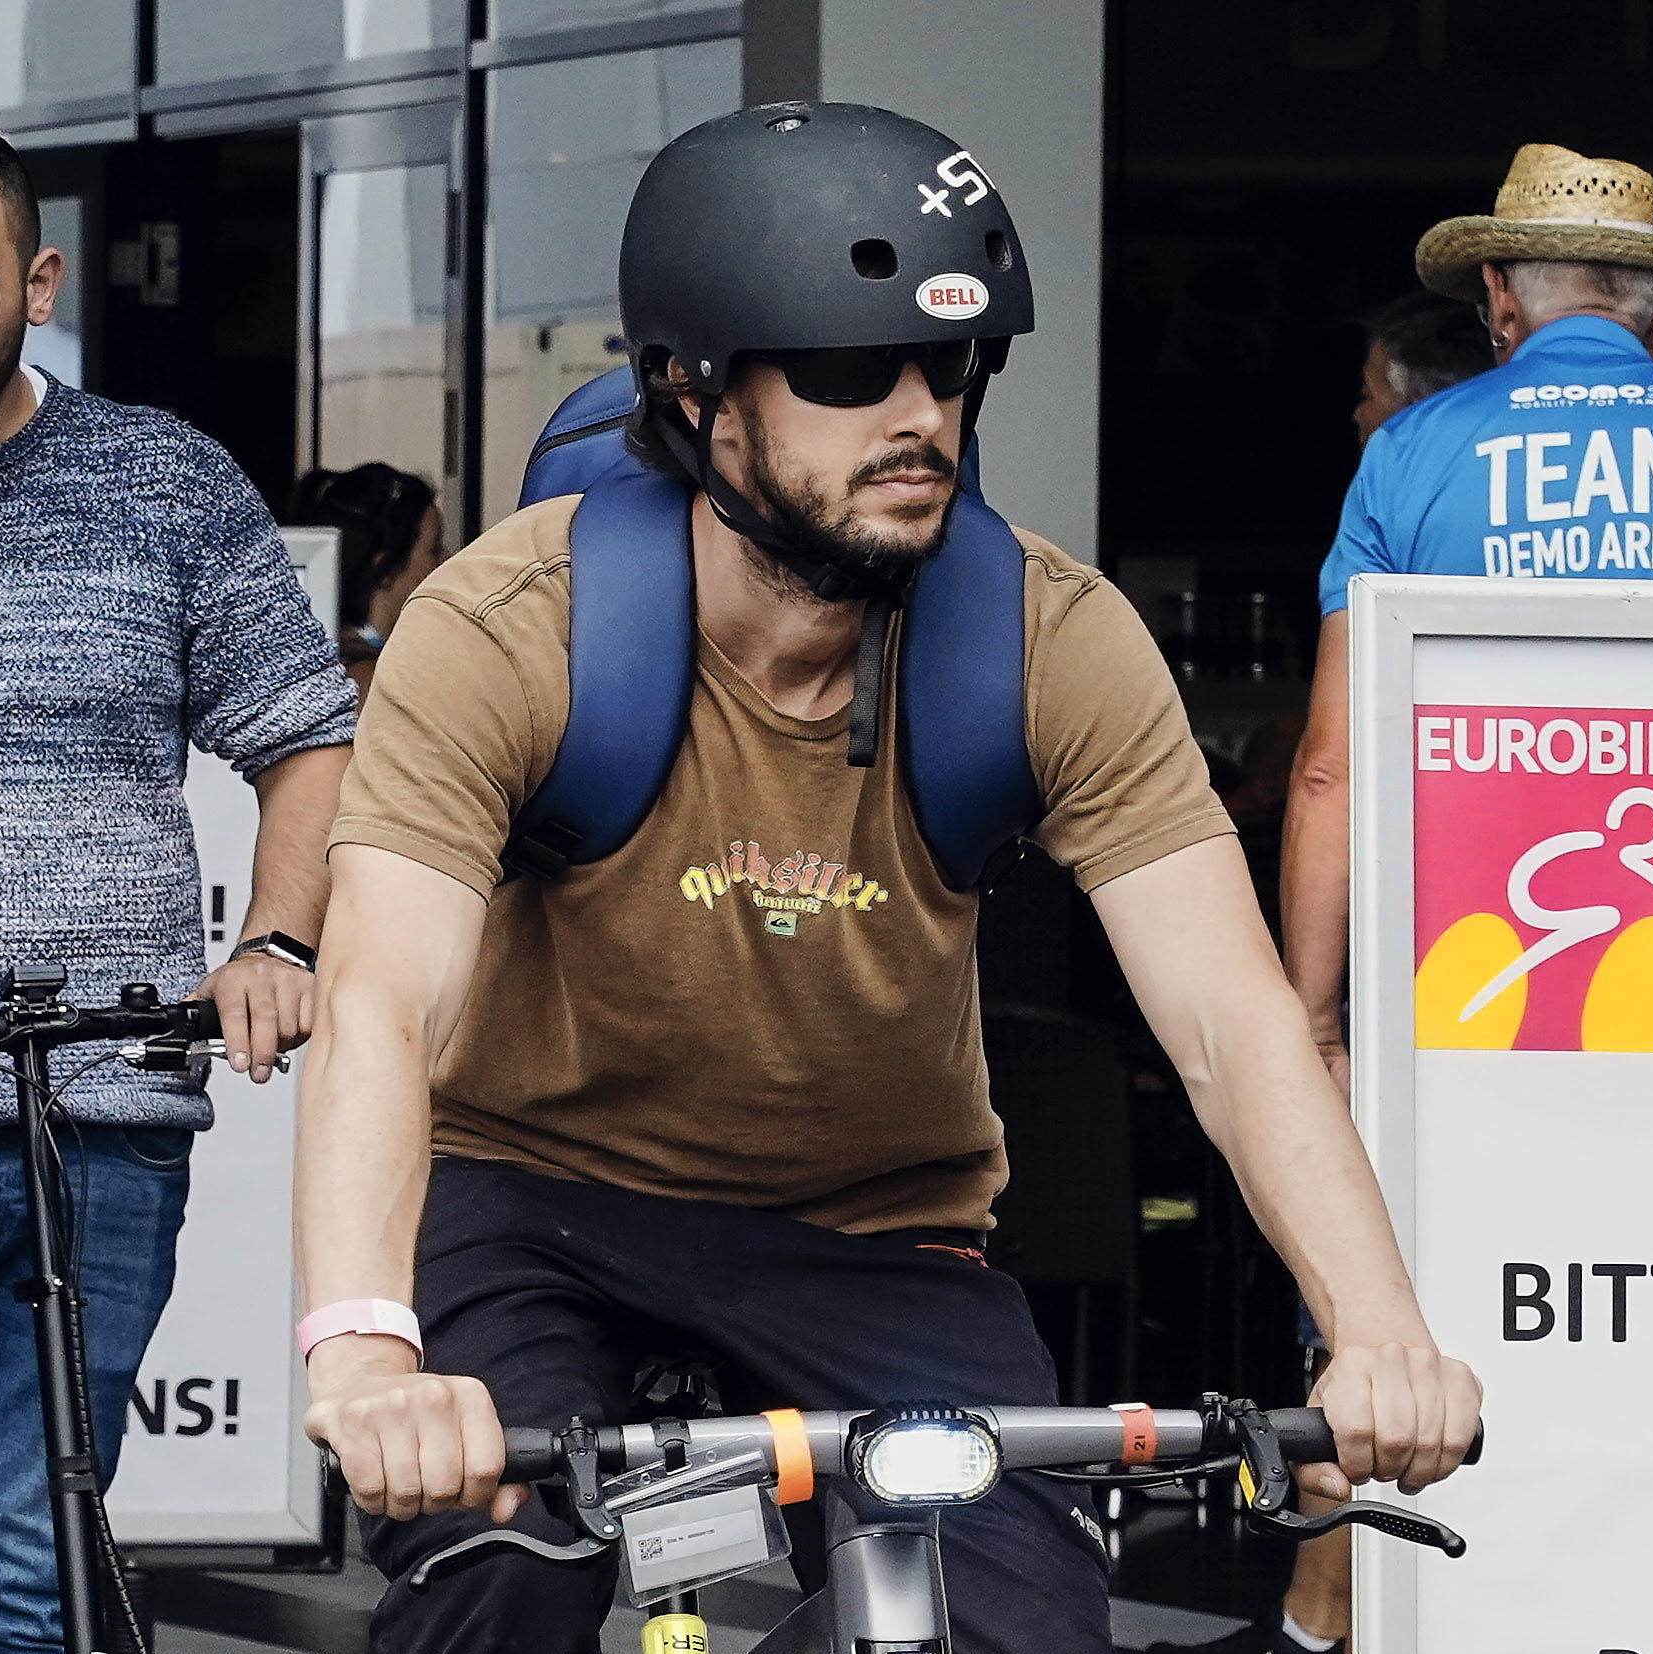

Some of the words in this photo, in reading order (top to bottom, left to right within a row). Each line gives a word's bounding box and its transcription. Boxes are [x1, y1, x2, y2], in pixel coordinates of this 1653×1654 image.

[929, 287, 979, 306] BELL
[1587, 399, 1617, 408] FOR
[1483, 525, 1591, 578] DEMO
